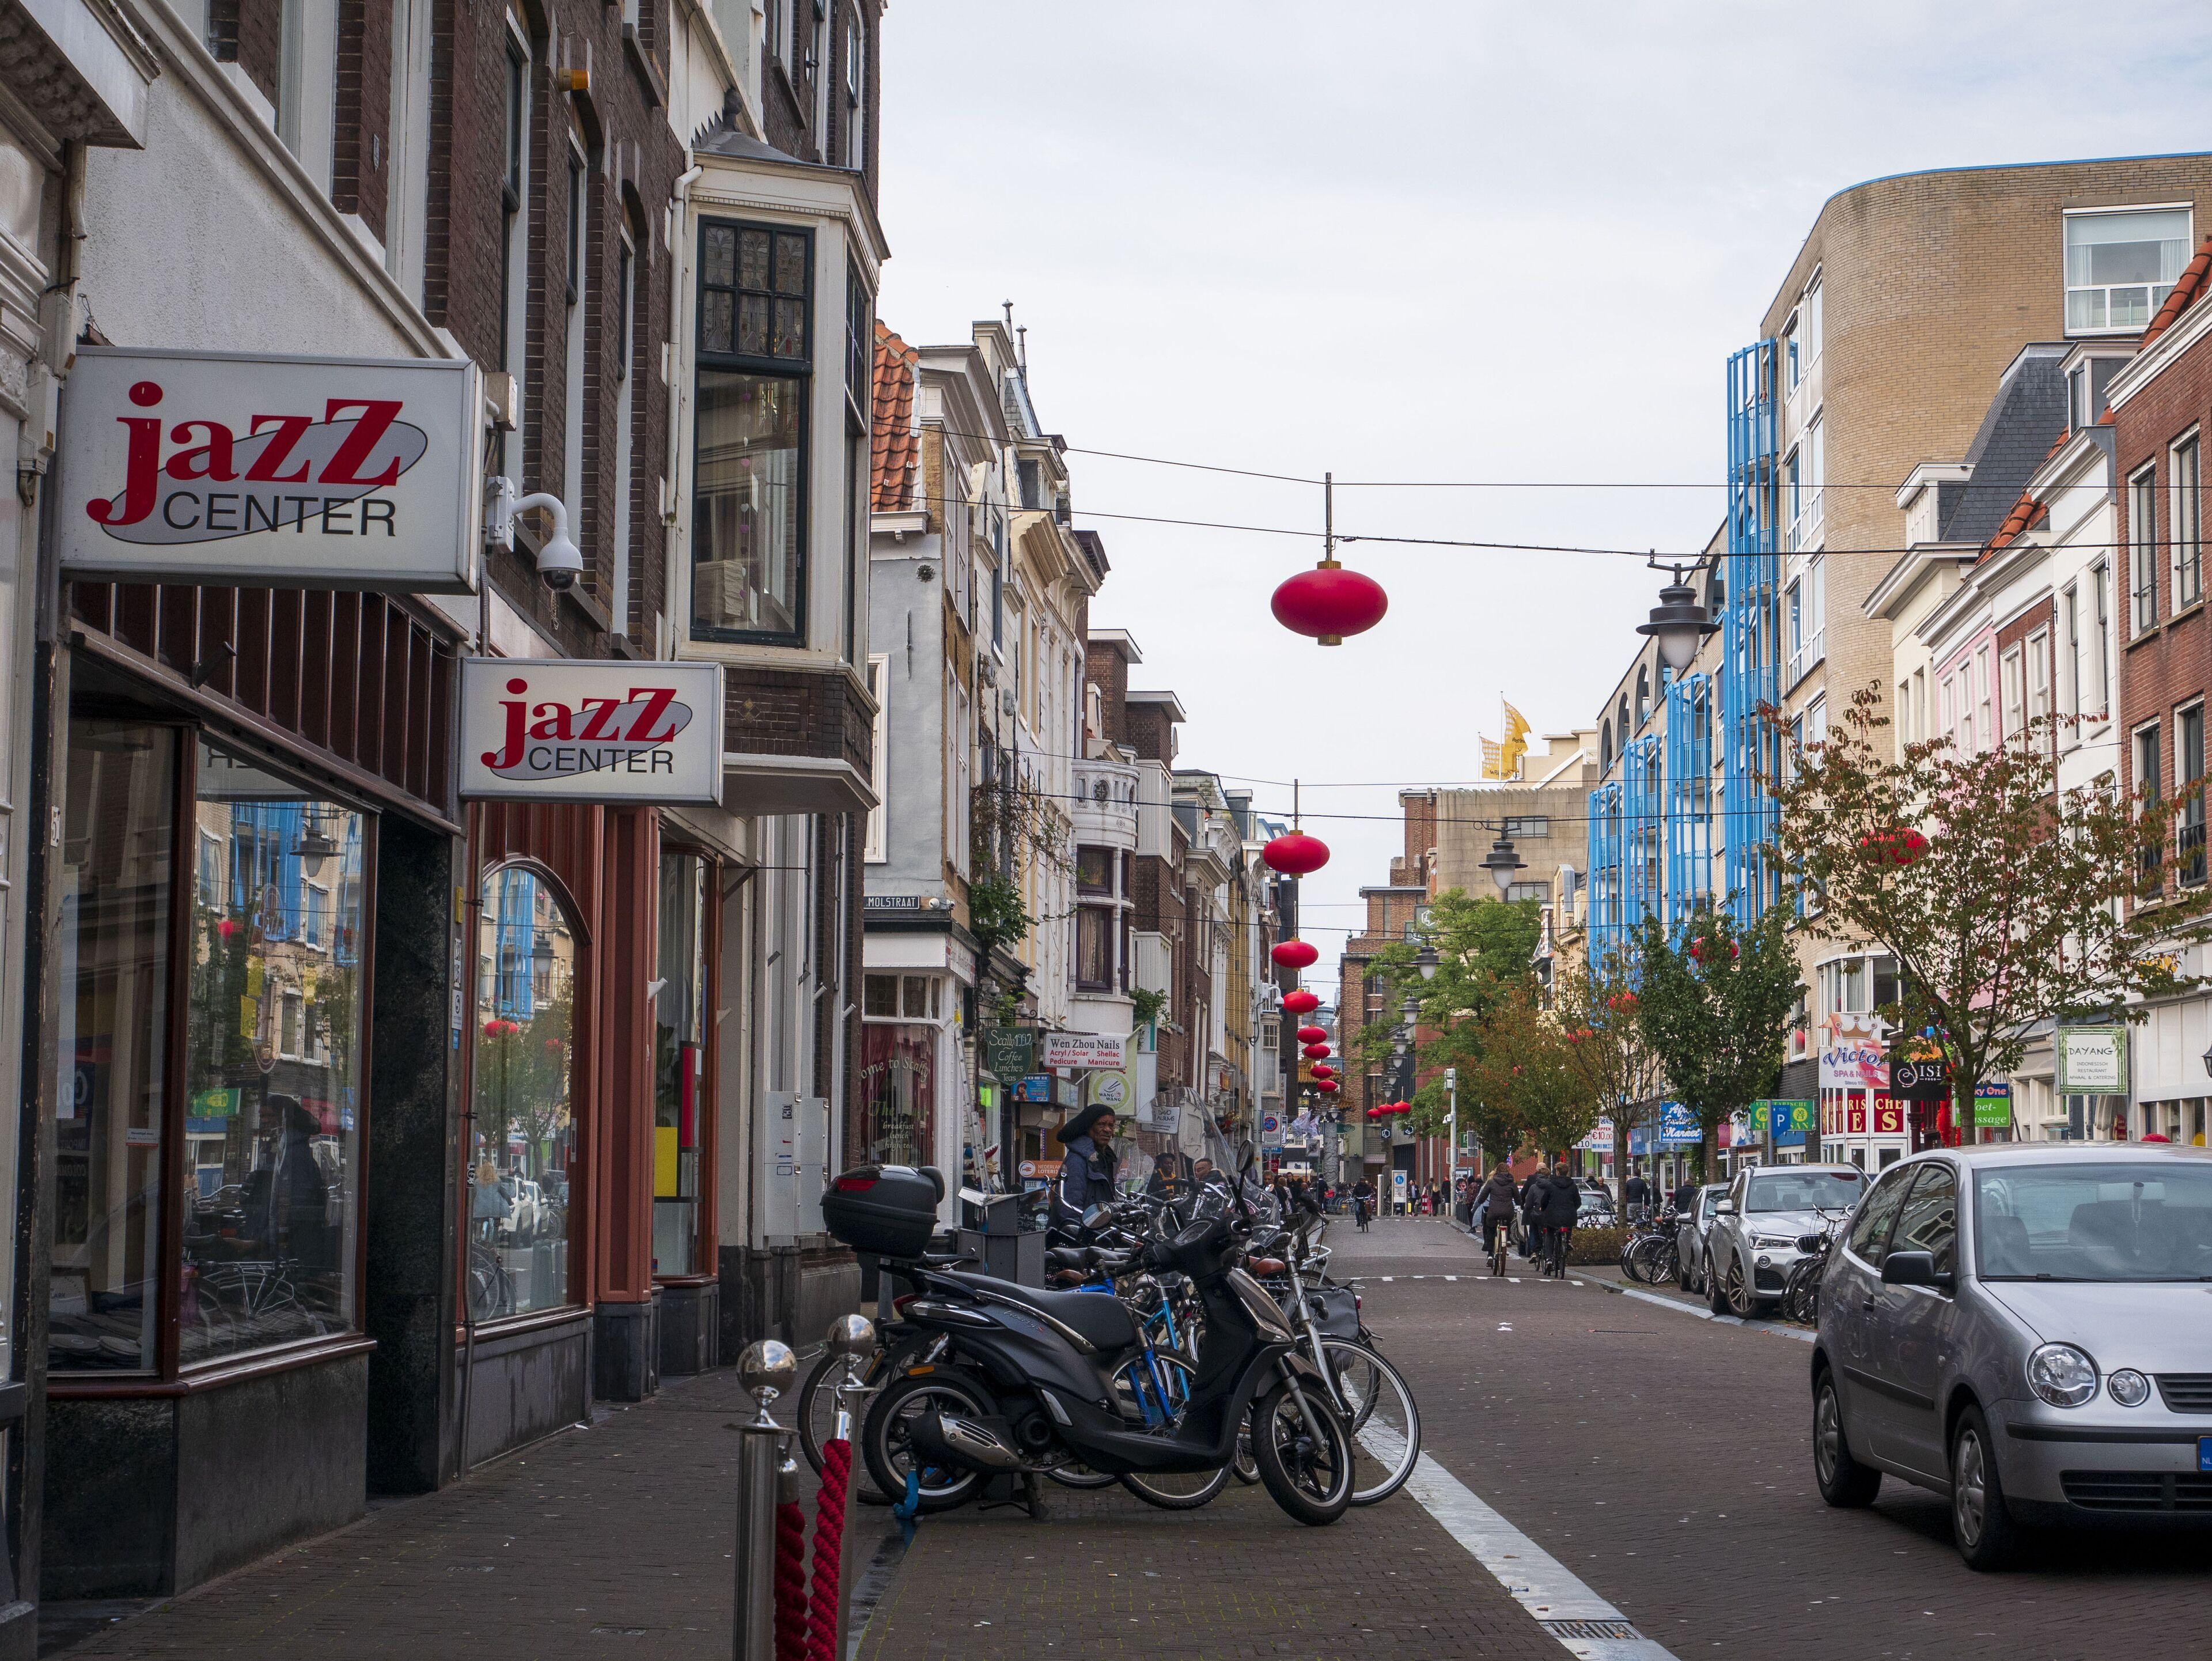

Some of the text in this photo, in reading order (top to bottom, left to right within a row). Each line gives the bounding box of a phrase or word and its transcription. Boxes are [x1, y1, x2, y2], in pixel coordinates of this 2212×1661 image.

[162, 491, 396, 538] CENTER
[528, 746, 673, 774] CENTER
[868, 898, 916, 907] MOLSTRAAT
[1014, 1034, 1032, 1046] 1992
[1050, 1038, 1120, 1049] Wen Zhou Nails
[2068, 1047, 2113, 1055] DAYANG
[998, 1050, 1022, 1064] Coffee
[888, 1058, 899, 1070] to
[903, 1056, 929, 1083] Scally
[994, 1062, 1024, 1072] Lunches
[1001, 1073, 1016, 1081] Teas
[1834, 1069, 1848, 1078] SPA
[1856, 1069, 1878, 1078] NAILS
[1987, 1087, 2007, 1095] One
[882, 1121, 914, 1132] breakfast
[889, 1130, 909, 1140] lunch
[884, 1141, 901, 1152] high
[2202, 1456, 2212, 1465] NL
